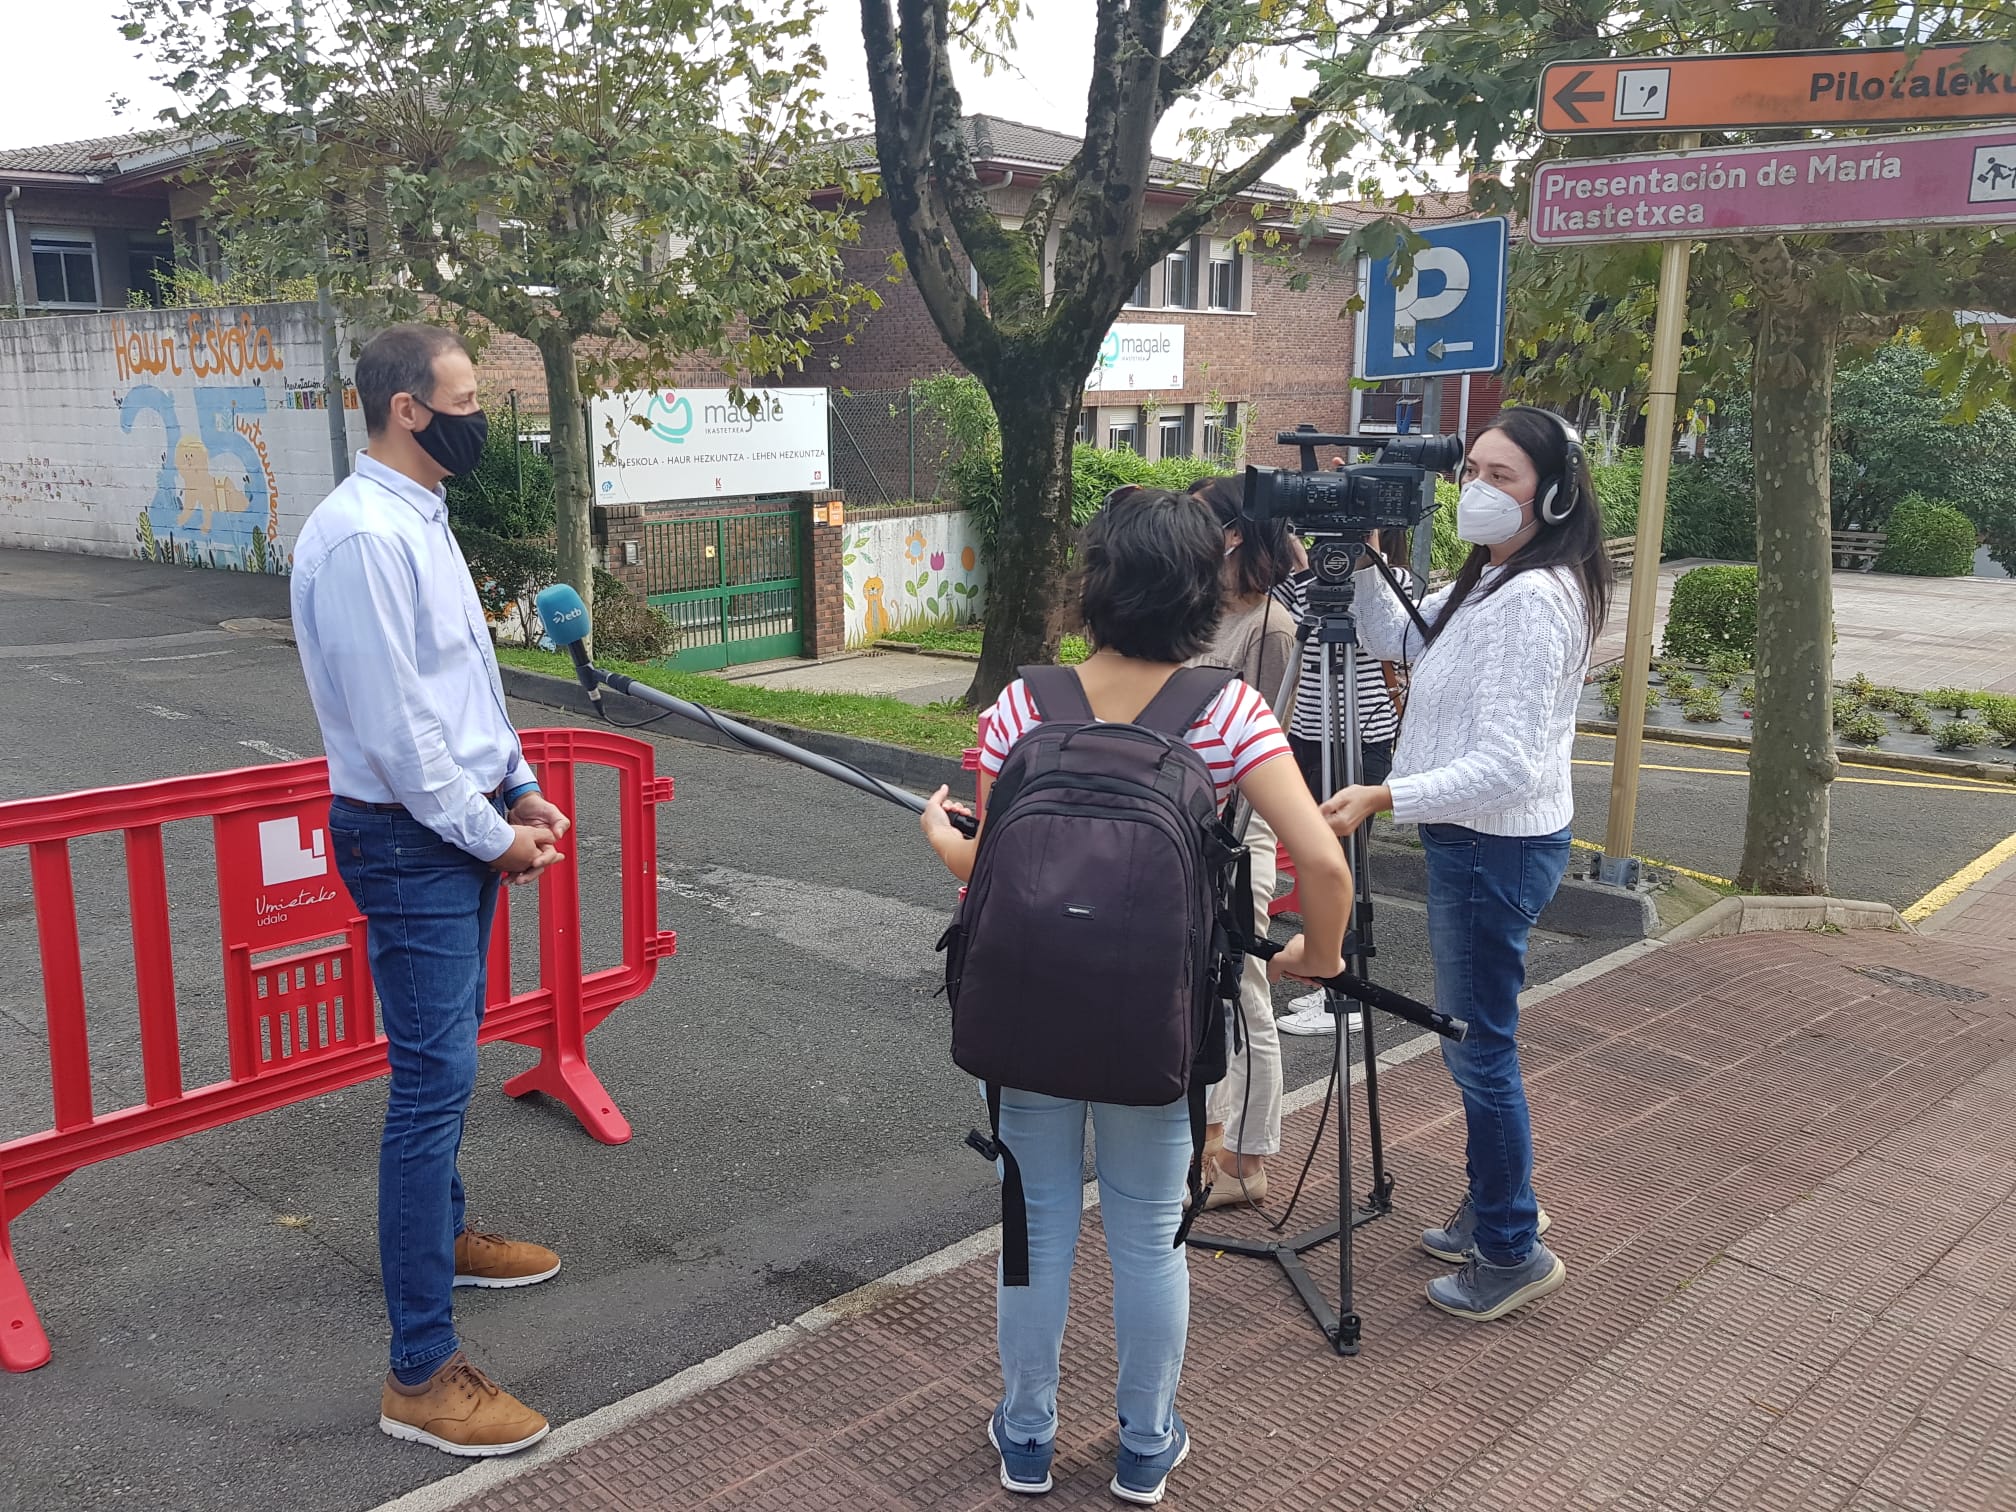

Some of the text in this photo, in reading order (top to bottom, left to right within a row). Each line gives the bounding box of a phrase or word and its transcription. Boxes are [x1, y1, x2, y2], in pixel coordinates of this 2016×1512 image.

[1545, 151, 1902, 201] Presentación de María
[1543, 200, 1705, 232] Ikastetxea
[112, 311, 283, 382] Haur Eskola
[1121, 331, 1170, 361] magale
[705, 396, 783, 433] magale
[626, 457, 659, 467] ESKOLA
[667, 455, 691, 465] HAUR
[694, 453, 744, 463] HEZKUNTZA
[752, 451, 777, 461] LEHEN
[779, 449, 825, 460] HEZKUNTZA
[565, 607, 582, 620] etb
[257, 912, 287, 927] udala
